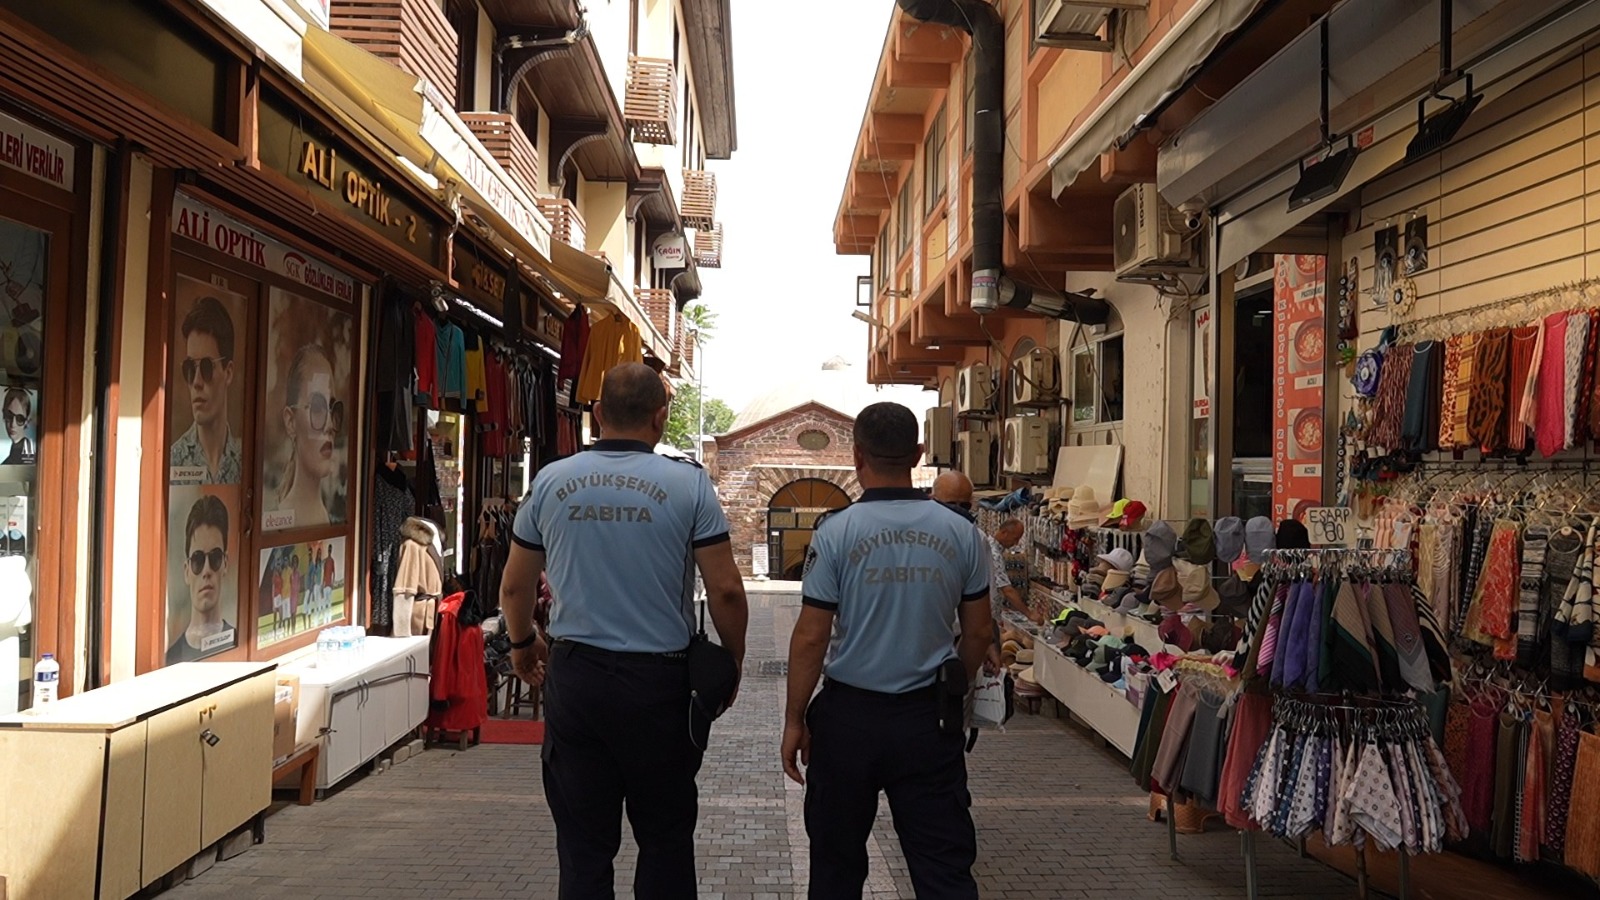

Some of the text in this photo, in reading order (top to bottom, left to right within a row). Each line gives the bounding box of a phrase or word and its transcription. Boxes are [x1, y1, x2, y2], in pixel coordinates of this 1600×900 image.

[26, 143, 65, 185] VERİLİR
[464, 149, 485, 192] ALİ
[302, 142, 336, 191] ALİ
[346, 171, 390, 227] OPTİK
[407, 215, 417, 243] 2
[176, 207, 267, 268] ALİ OPTİK
[285, 259, 302, 279] SGK
[1275, 429, 1286, 494] Zevkle
[555, 471, 668, 505] BÜYÜKŞEHİR
[567, 505, 653, 523] ZABITA
[849, 527, 957, 566] BÜYÜKŞEHİR
[864, 566, 944, 584] ZABITA
